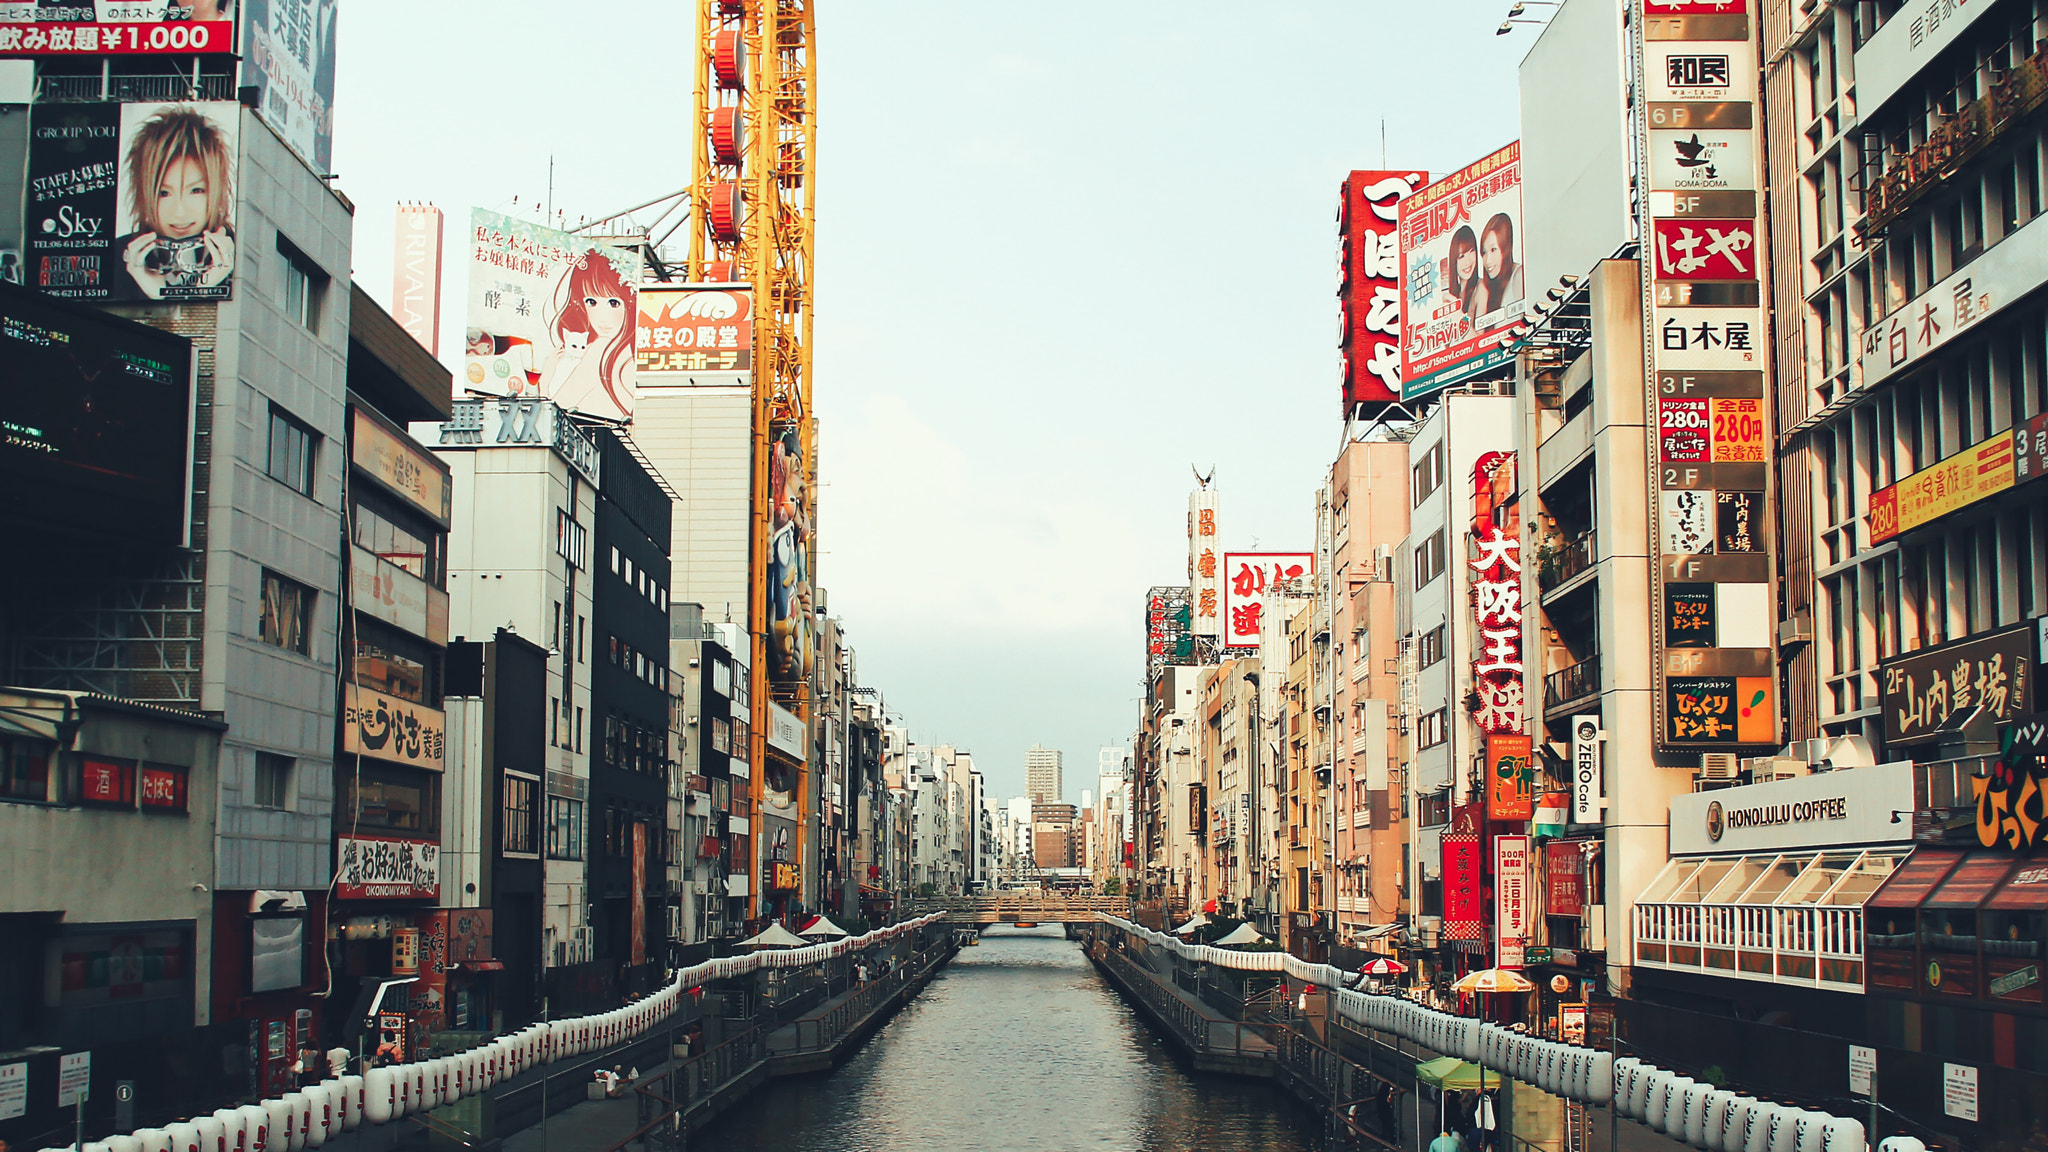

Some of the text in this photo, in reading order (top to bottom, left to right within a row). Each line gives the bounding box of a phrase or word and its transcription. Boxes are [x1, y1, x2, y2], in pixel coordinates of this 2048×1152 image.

[108, 6, 194, 19] のホストクラブ
[1670, 58, 1726, 84] 和民
[37, 126, 116, 138] GROUP YOU
[1675, 197, 1700, 213] 5F
[59, 205, 102, 237] Sky
[476, 226, 588, 271] 私を本気にさせる
[1658, 227, 1752, 275] はや
[475, 247, 550, 279] お嬢様酵素
[180, 273, 209, 285] YOU
[1663, 317, 1752, 350] 白木屋
[1866, 277, 1976, 369] 4F 白木屋
[637, 325, 738, 348] 激安の殿堂
[1662, 401, 1706, 410] ドリンク全品
[1717, 400, 1757, 413] 全品
[1661, 411, 1708, 428] 280円
[1714, 414, 1762, 443] 280円
[1718, 493, 1732, 503] 2F
[1735, 493, 1751, 551] 山内農場
[1469, 529, 1523, 733] 大阪王将
[1673, 616, 1710, 629] ドンキー
[1676, 694, 1729, 716] びっくり
[1886, 667, 1904, 695] 2F
[1898, 652, 2007, 734] 山内農場
[361, 698, 421, 759] うなぎ
[1673, 716, 1733, 738] ドンキー
[1578, 743, 1593, 784] ZERO
[96, 769, 110, 795] 酒
[143, 776, 174, 800] たばこ
[1494, 808, 1529, 816] ミティラー
[1727, 797, 1847, 828] HONOLULU COFFEE
[361, 841, 413, 882] お好み焼
[365, 885, 411, 897] OKONOMIYAKI
[1510, 878, 1521, 929] 三日月百子
